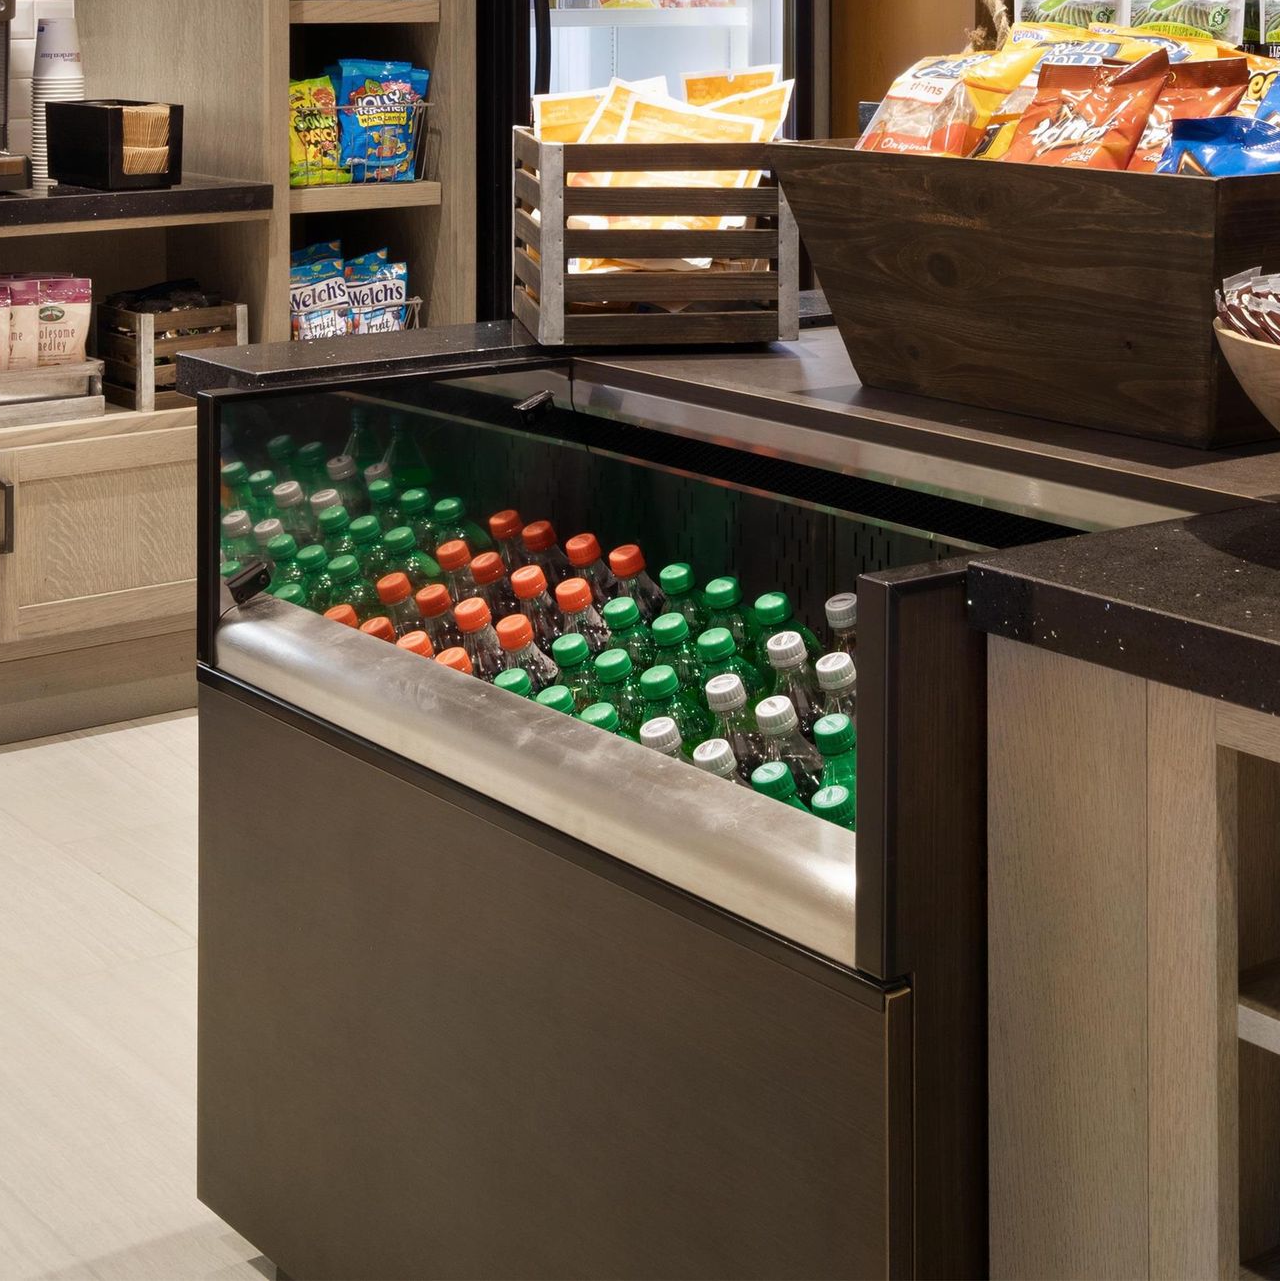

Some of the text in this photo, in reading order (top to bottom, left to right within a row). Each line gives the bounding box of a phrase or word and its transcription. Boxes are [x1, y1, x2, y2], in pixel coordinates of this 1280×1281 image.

[911, 81, 944, 96] thins
[357, 90, 402, 106] JOLLY
[881, 138, 931, 151] Original
[348, 284, 403, 306] Welch's
